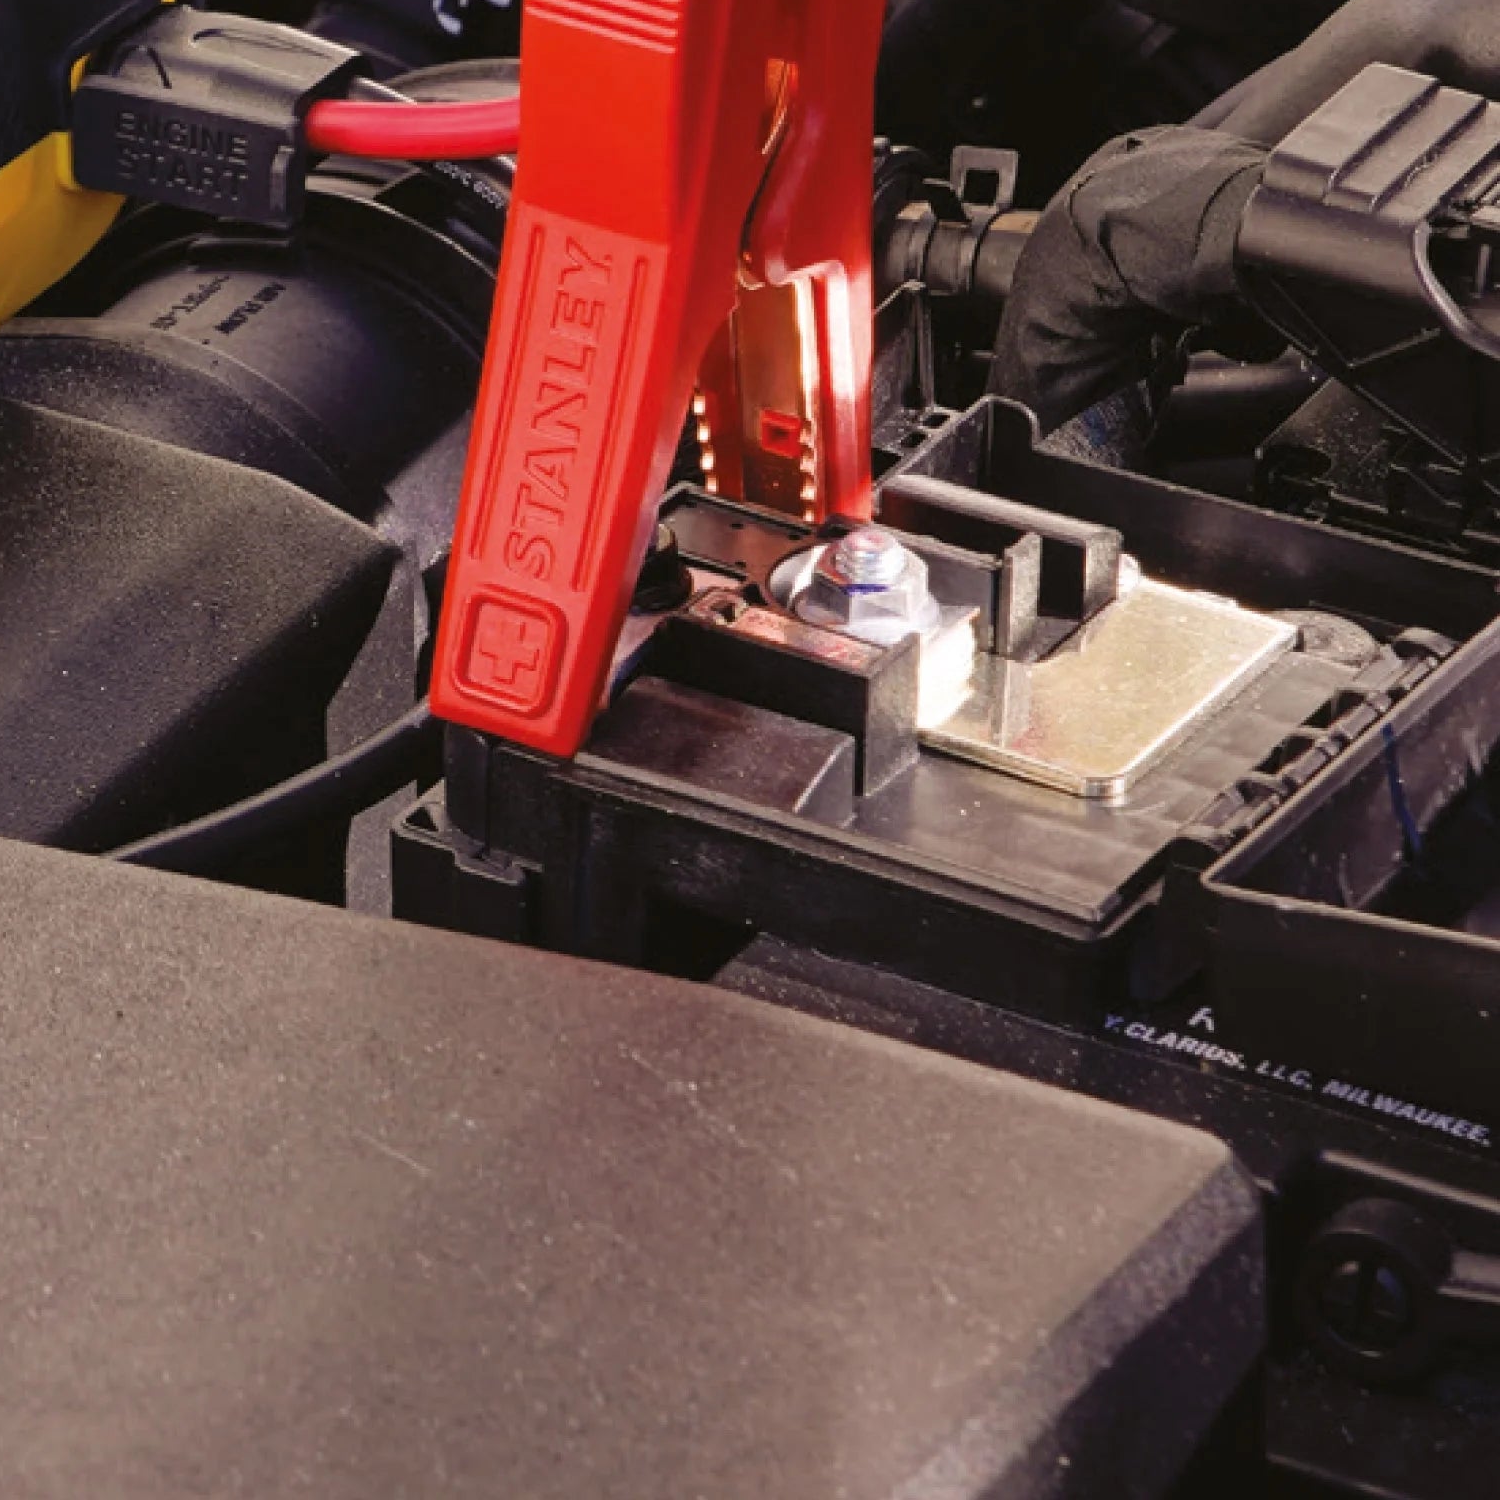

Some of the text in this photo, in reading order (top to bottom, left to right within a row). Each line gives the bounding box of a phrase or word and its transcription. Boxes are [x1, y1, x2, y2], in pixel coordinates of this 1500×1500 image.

[116, 112, 249, 166] ENGINE
[116, 149, 249, 202] START
[503, 236, 614, 582] STANLEY
